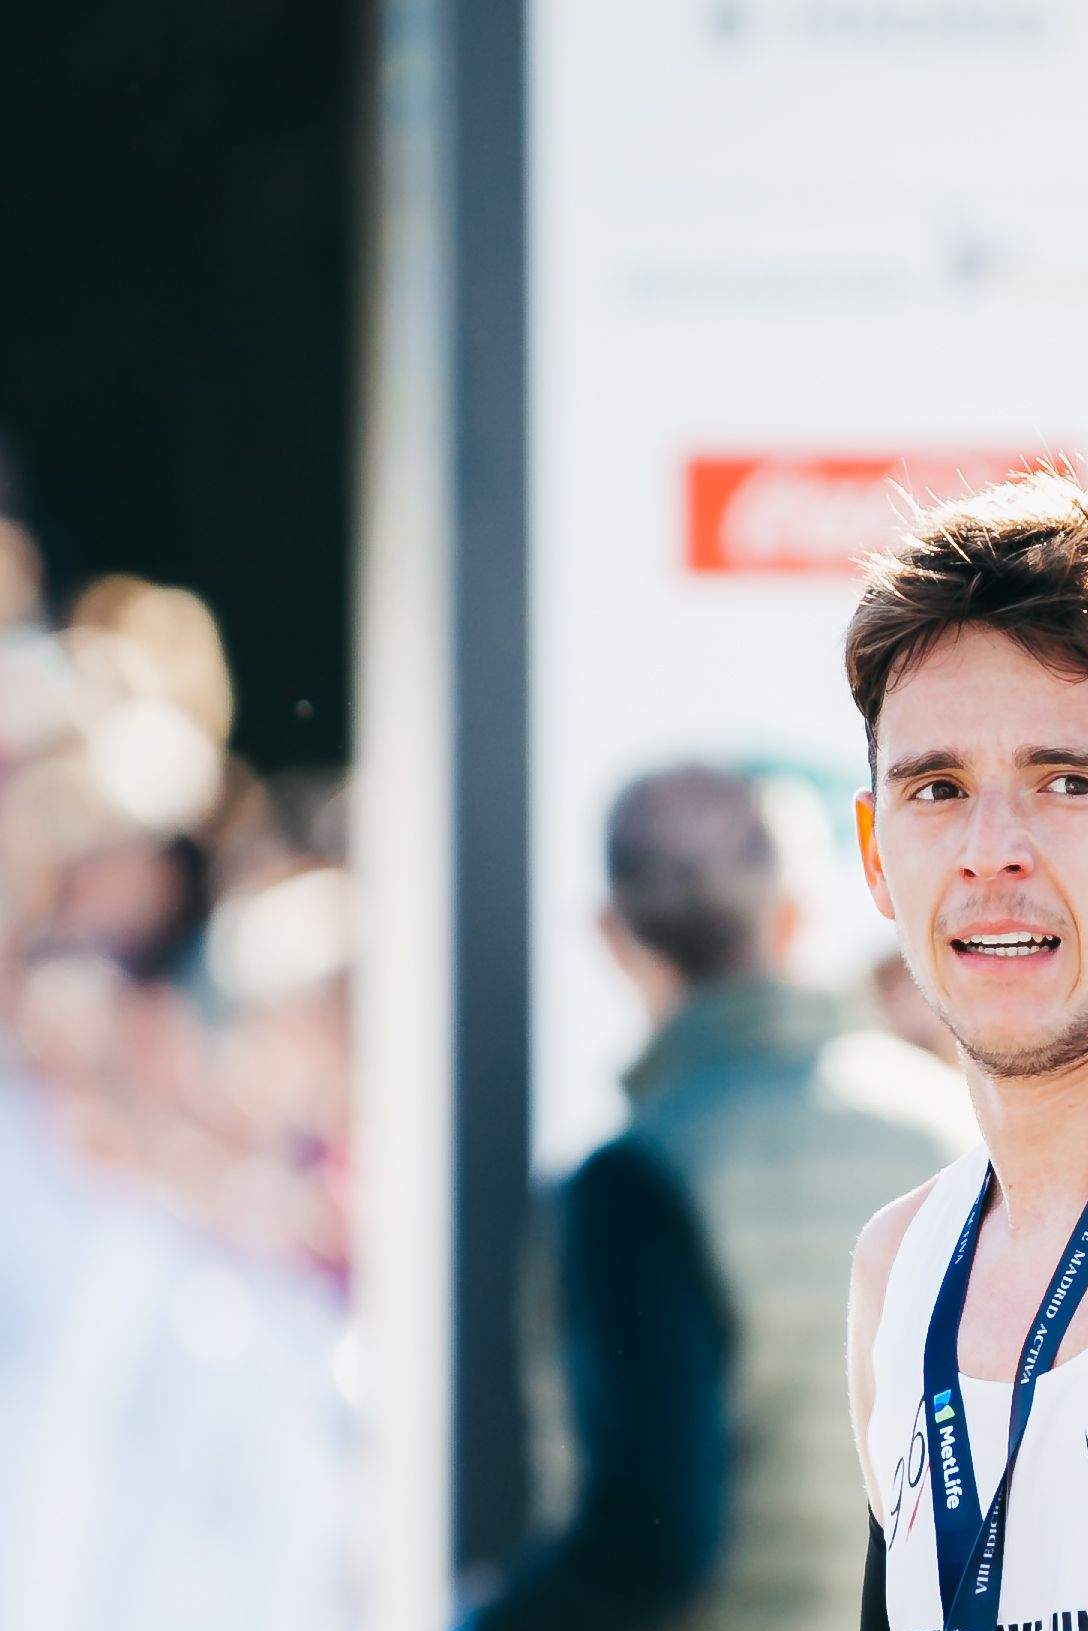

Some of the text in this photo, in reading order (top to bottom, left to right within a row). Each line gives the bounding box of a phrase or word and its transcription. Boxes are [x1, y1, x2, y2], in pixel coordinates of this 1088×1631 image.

[1044, 1249, 1087, 1320] MADRID
[1019, 1323, 1049, 1387] ACTIVA
[939, 1425, 963, 1511] MetLife
